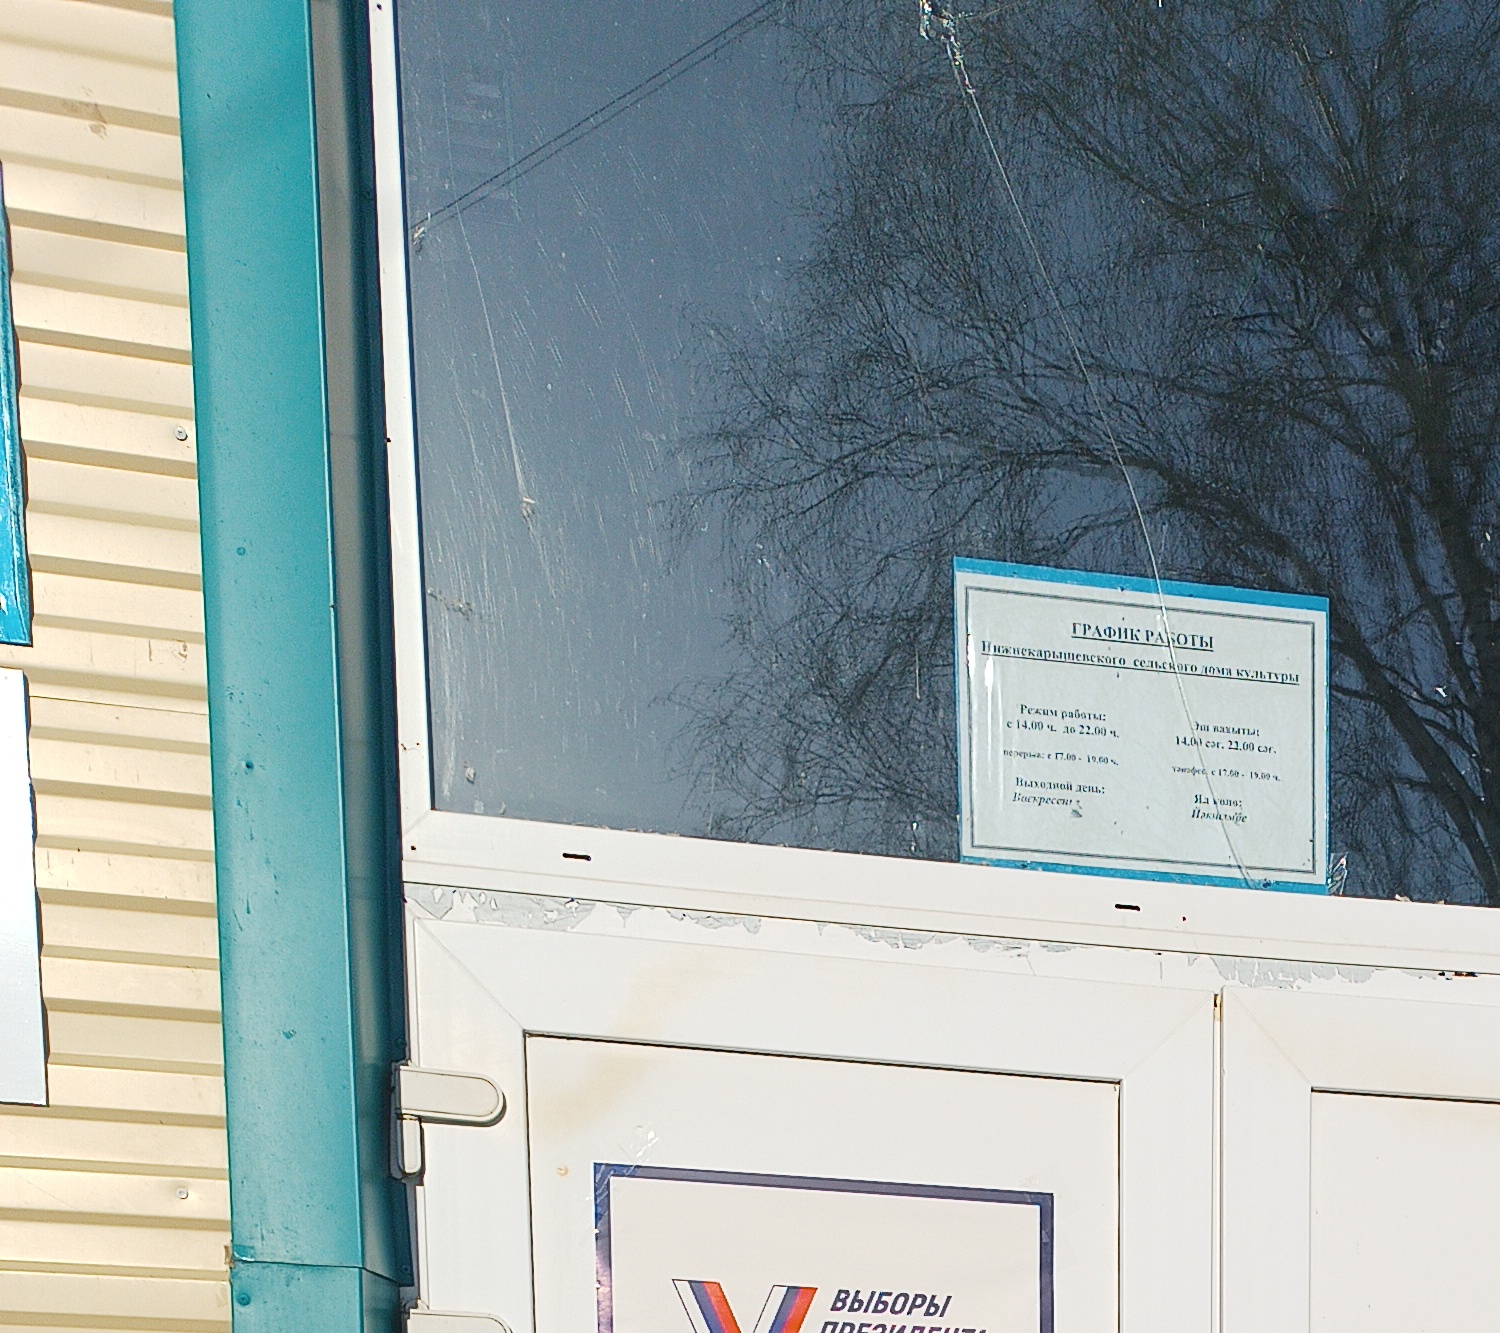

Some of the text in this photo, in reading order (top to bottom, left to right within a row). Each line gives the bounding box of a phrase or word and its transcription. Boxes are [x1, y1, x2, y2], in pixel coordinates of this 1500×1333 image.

[1072, 622, 1214, 649] ГРАФИК РАБОТЫ
[981, 640, 1300, 684] Нижнекарышевского сельского дома культуры
[1020, 703, 1106, 722] Режим работы:
[1006, 720, 1013, 729] с
[1016, 719, 1044, 731] 14.00
[1062, 725, 1076, 735] до
[1078, 724, 1107, 737] 22.00
[1175, 735, 1203, 748] 14.00
[1015, 776, 1073, 792] Выходной
[829, 1288, 953, 1318] ВЫБОРЫ
